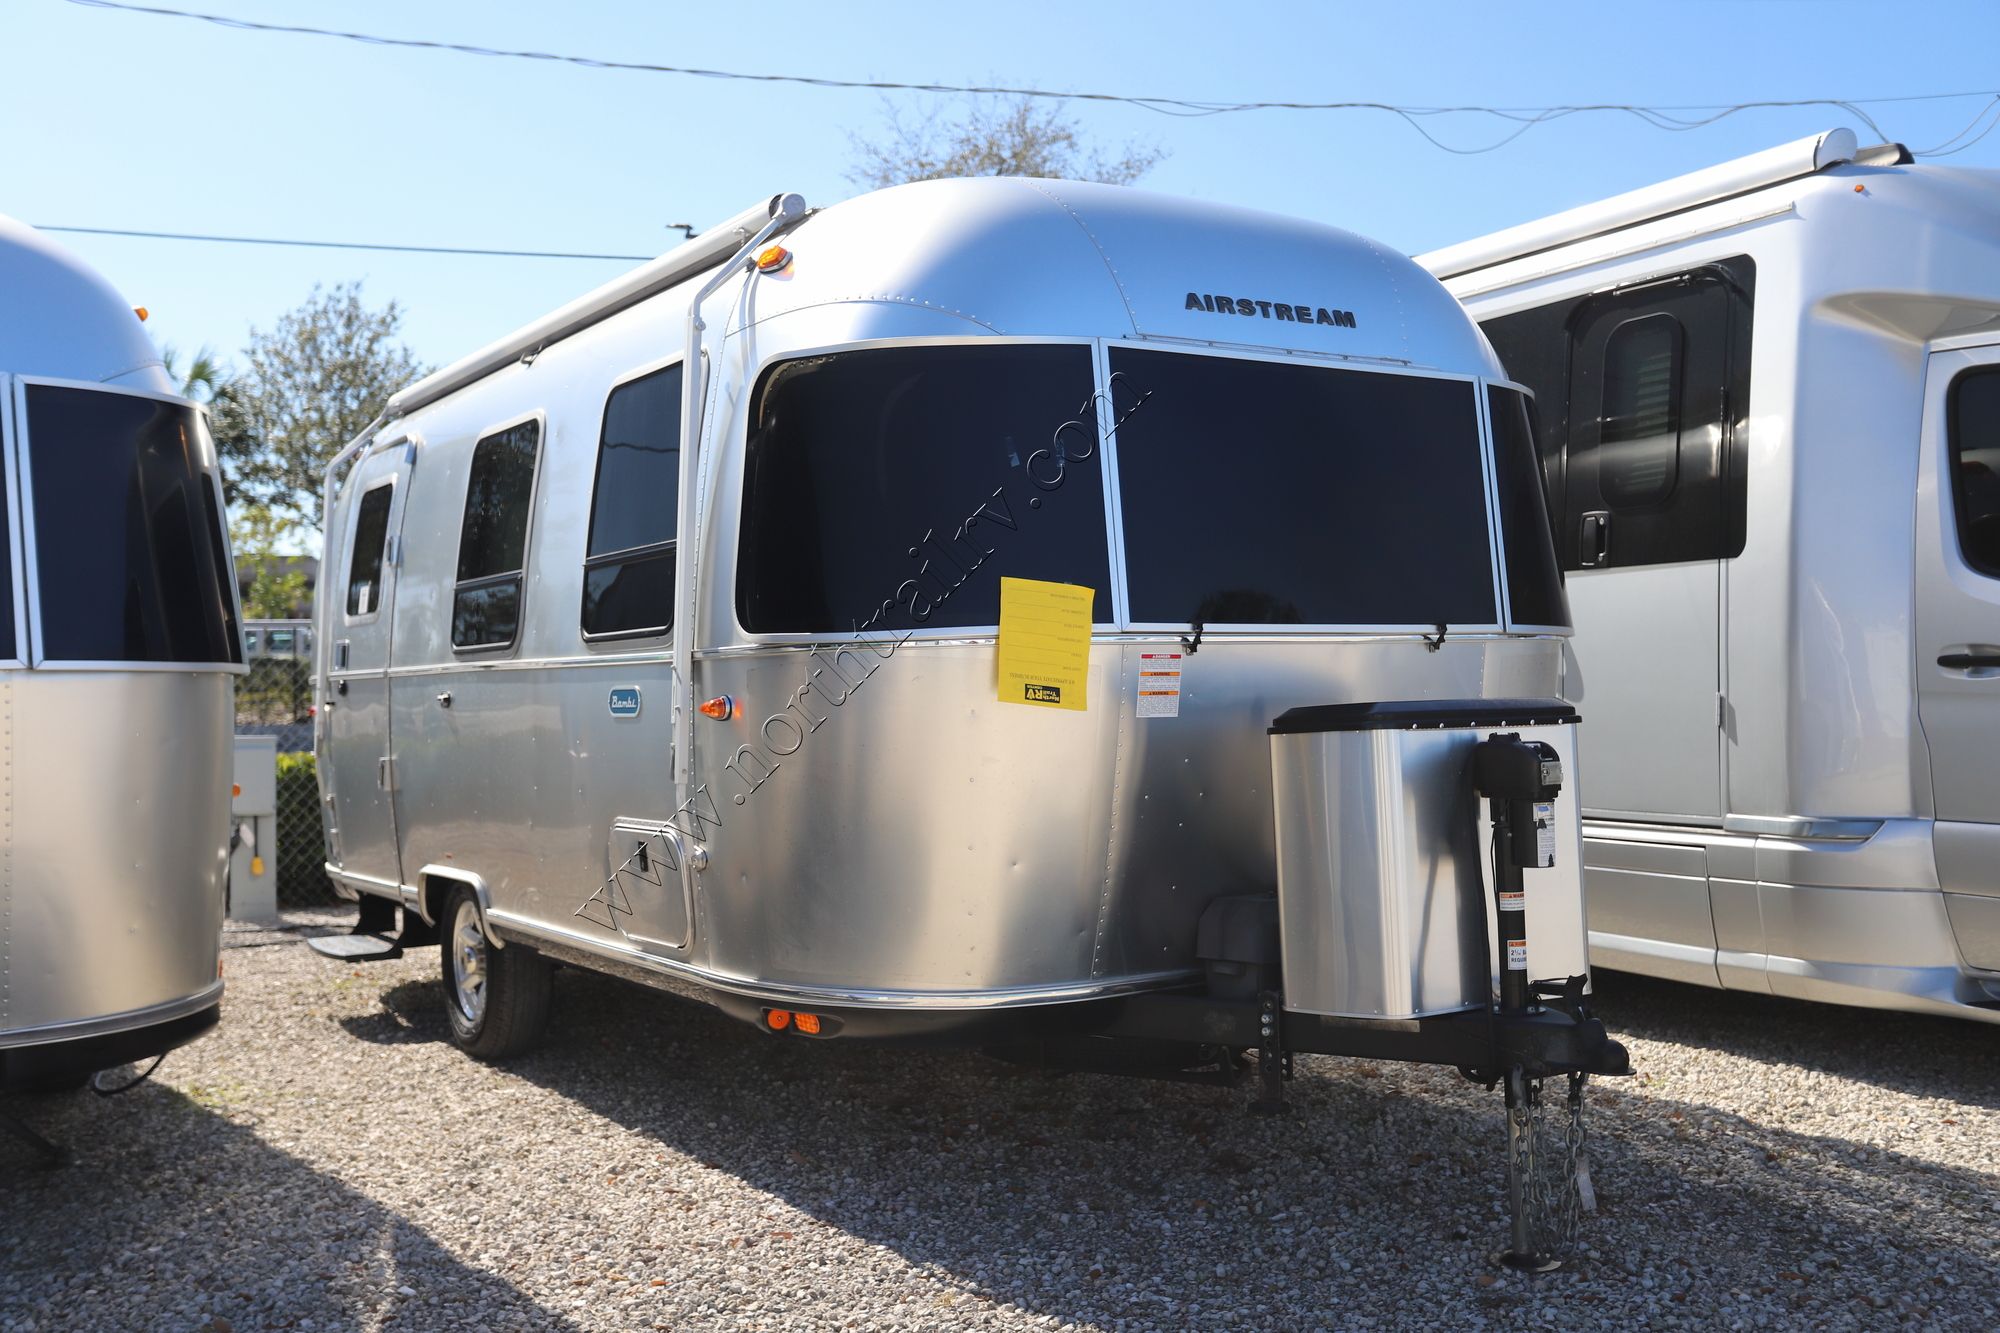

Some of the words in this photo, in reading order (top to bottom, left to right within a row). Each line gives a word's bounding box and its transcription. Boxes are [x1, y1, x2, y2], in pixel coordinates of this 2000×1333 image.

[1185, 292, 1357, 329] AIRSTREAM
[1026, 688, 1043, 700] RV
[1042, 694, 1060, 702] North
[611, 695, 638, 708] Bambi
